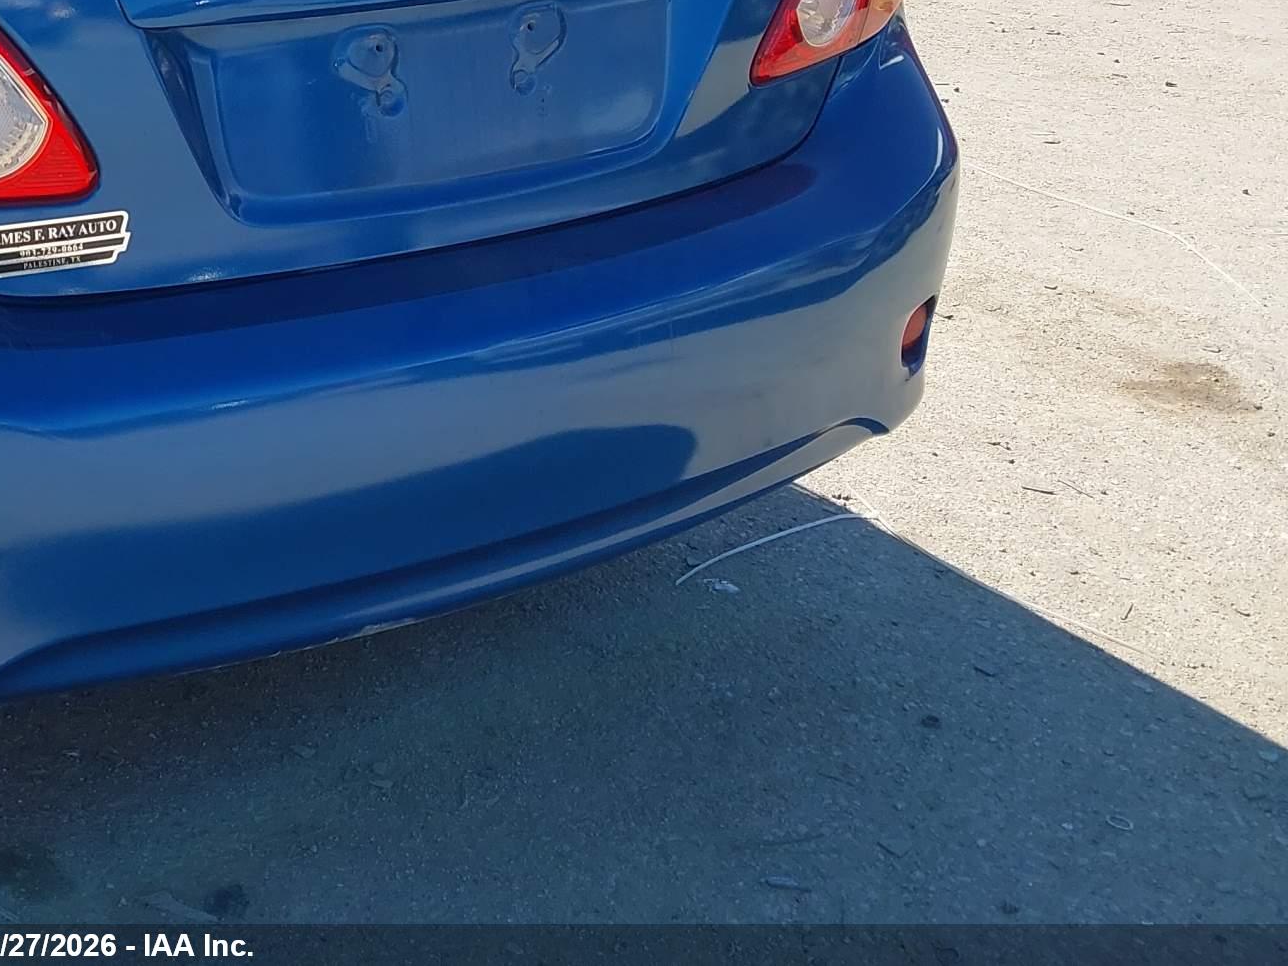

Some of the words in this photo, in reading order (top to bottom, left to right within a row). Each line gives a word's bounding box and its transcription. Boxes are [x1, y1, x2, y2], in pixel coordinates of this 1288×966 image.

[34, 228, 45, 241] F.
[48, 224, 76, 240] RAY
[78, 220, 117, 235] AUTO
